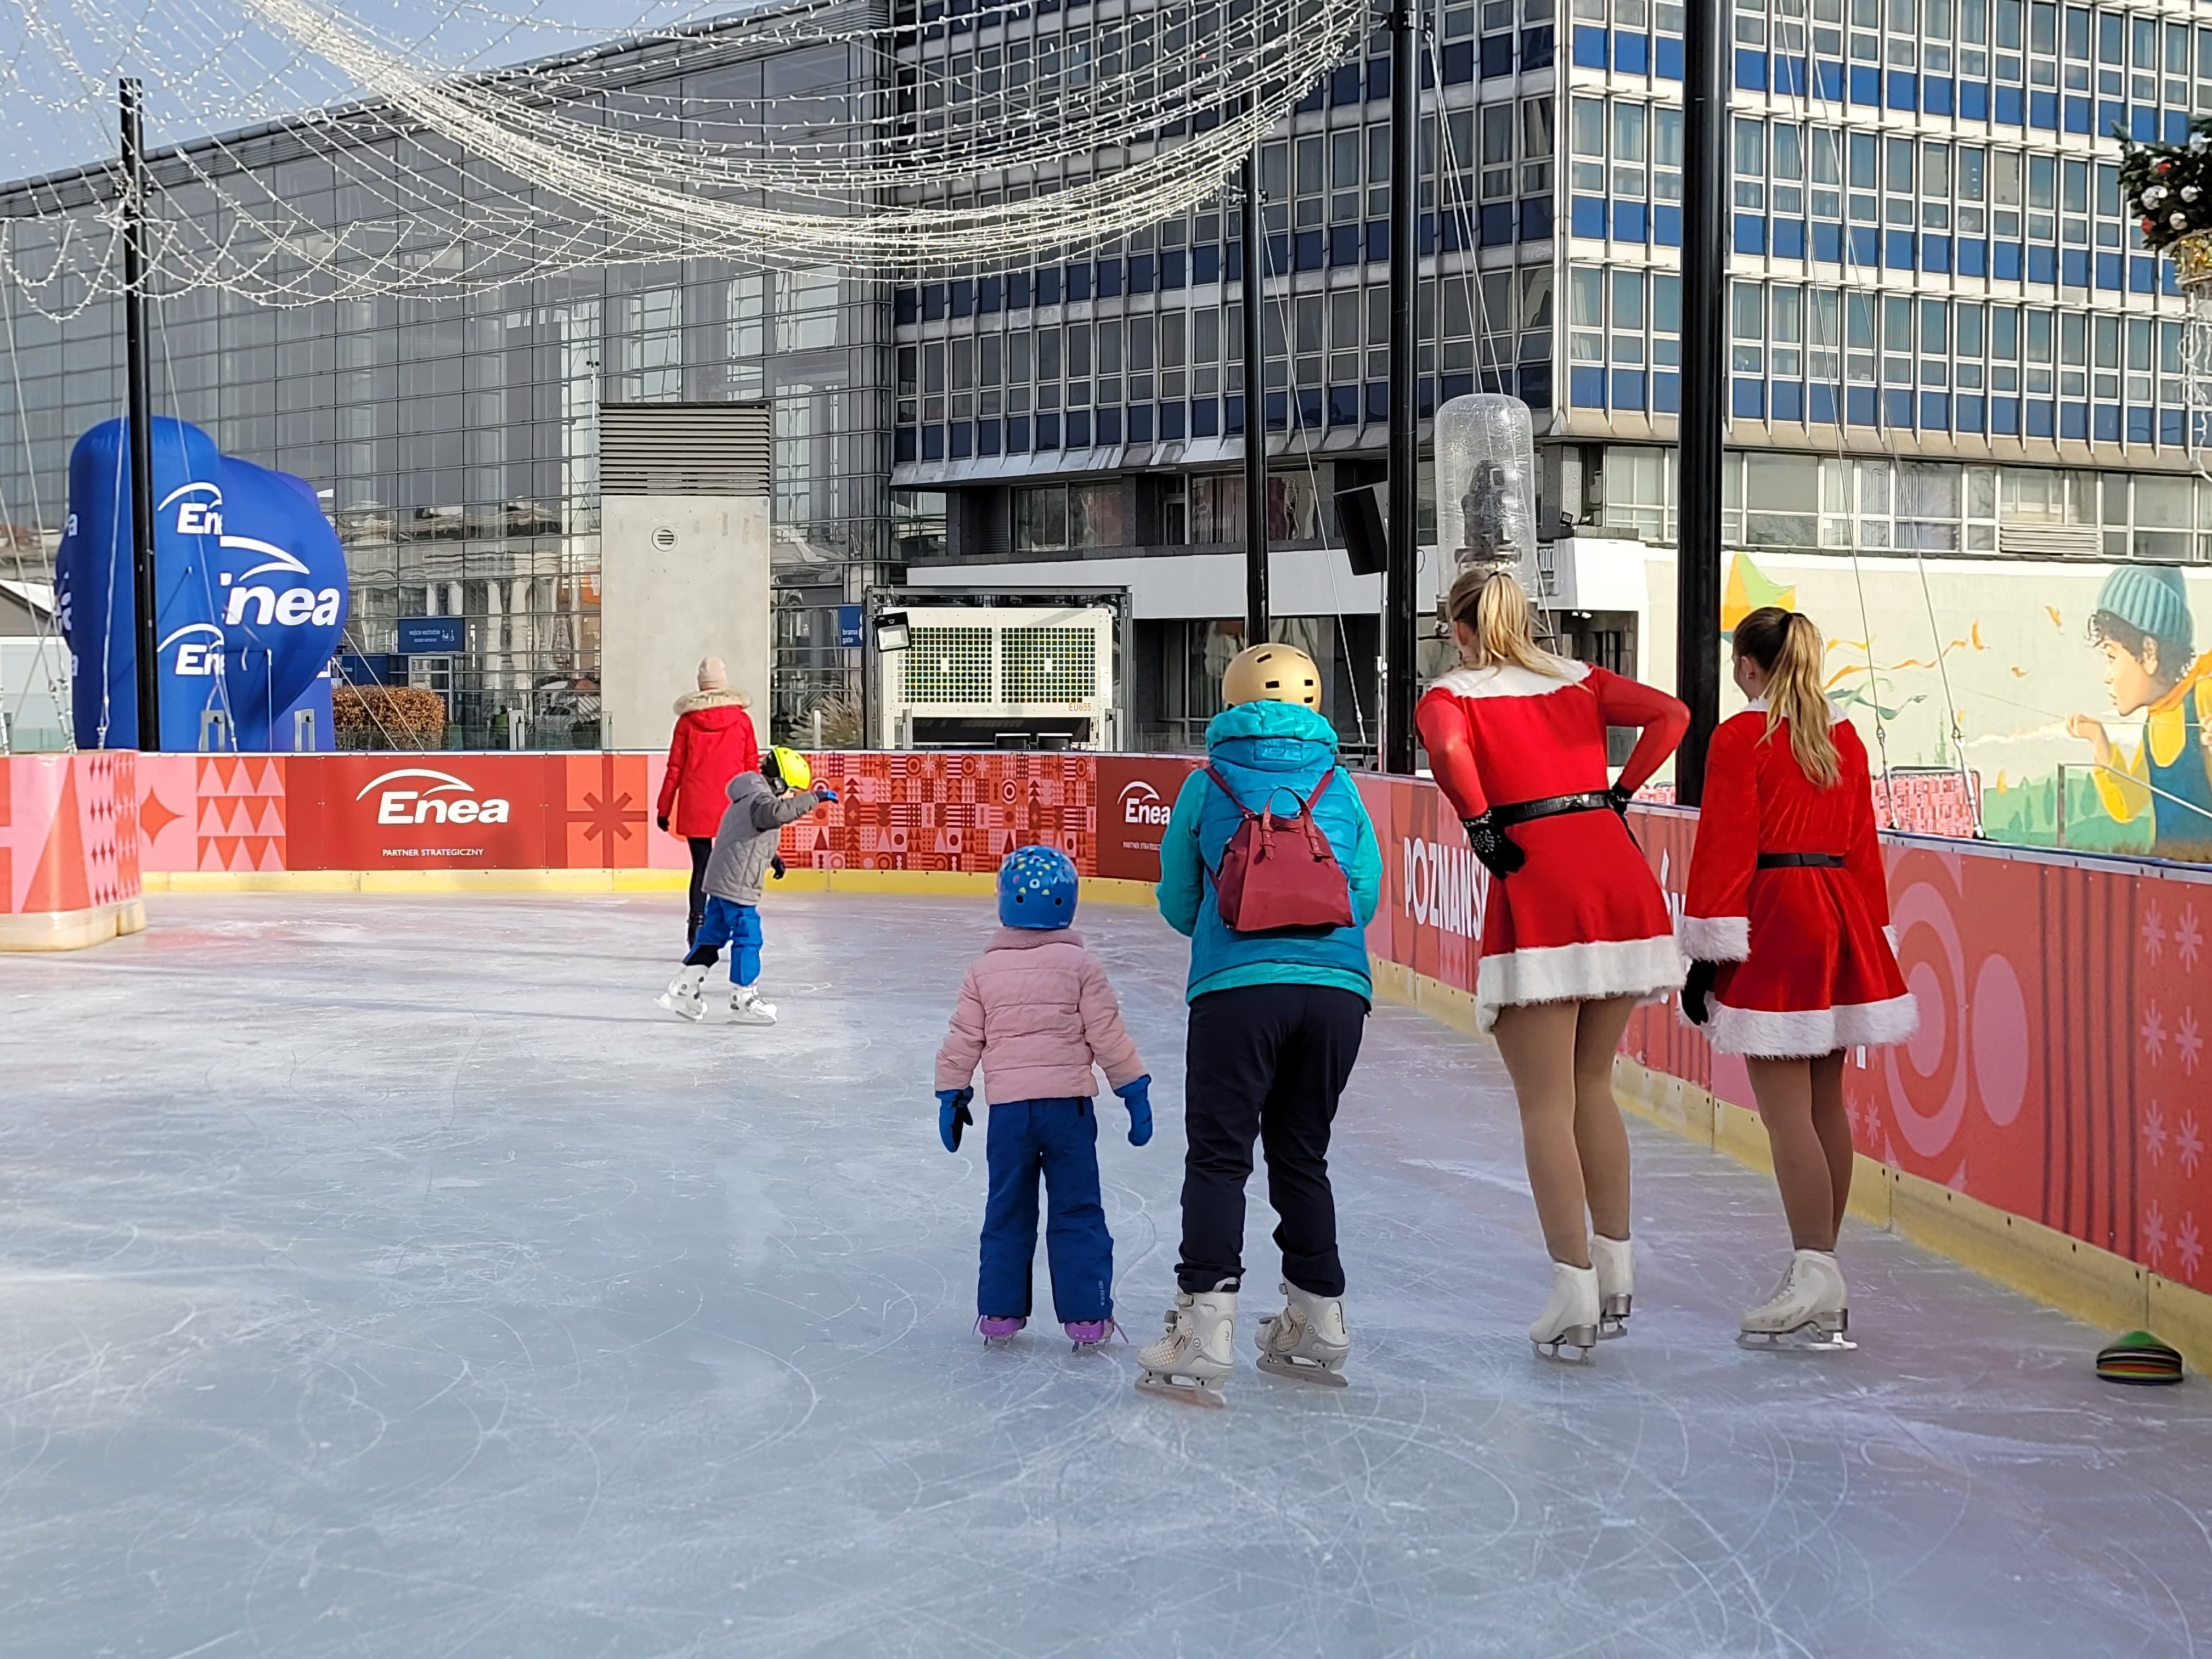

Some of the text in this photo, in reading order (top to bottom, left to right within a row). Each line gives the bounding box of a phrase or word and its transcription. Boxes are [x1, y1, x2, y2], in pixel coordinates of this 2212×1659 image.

[177, 503, 223, 535] En
[842, 636, 854, 645] gate
[176, 644, 224, 675] En
[1069, 703, 1092, 712] EU655
[377, 791, 509, 824] Enea
[1125, 798, 1171, 825] Enea
